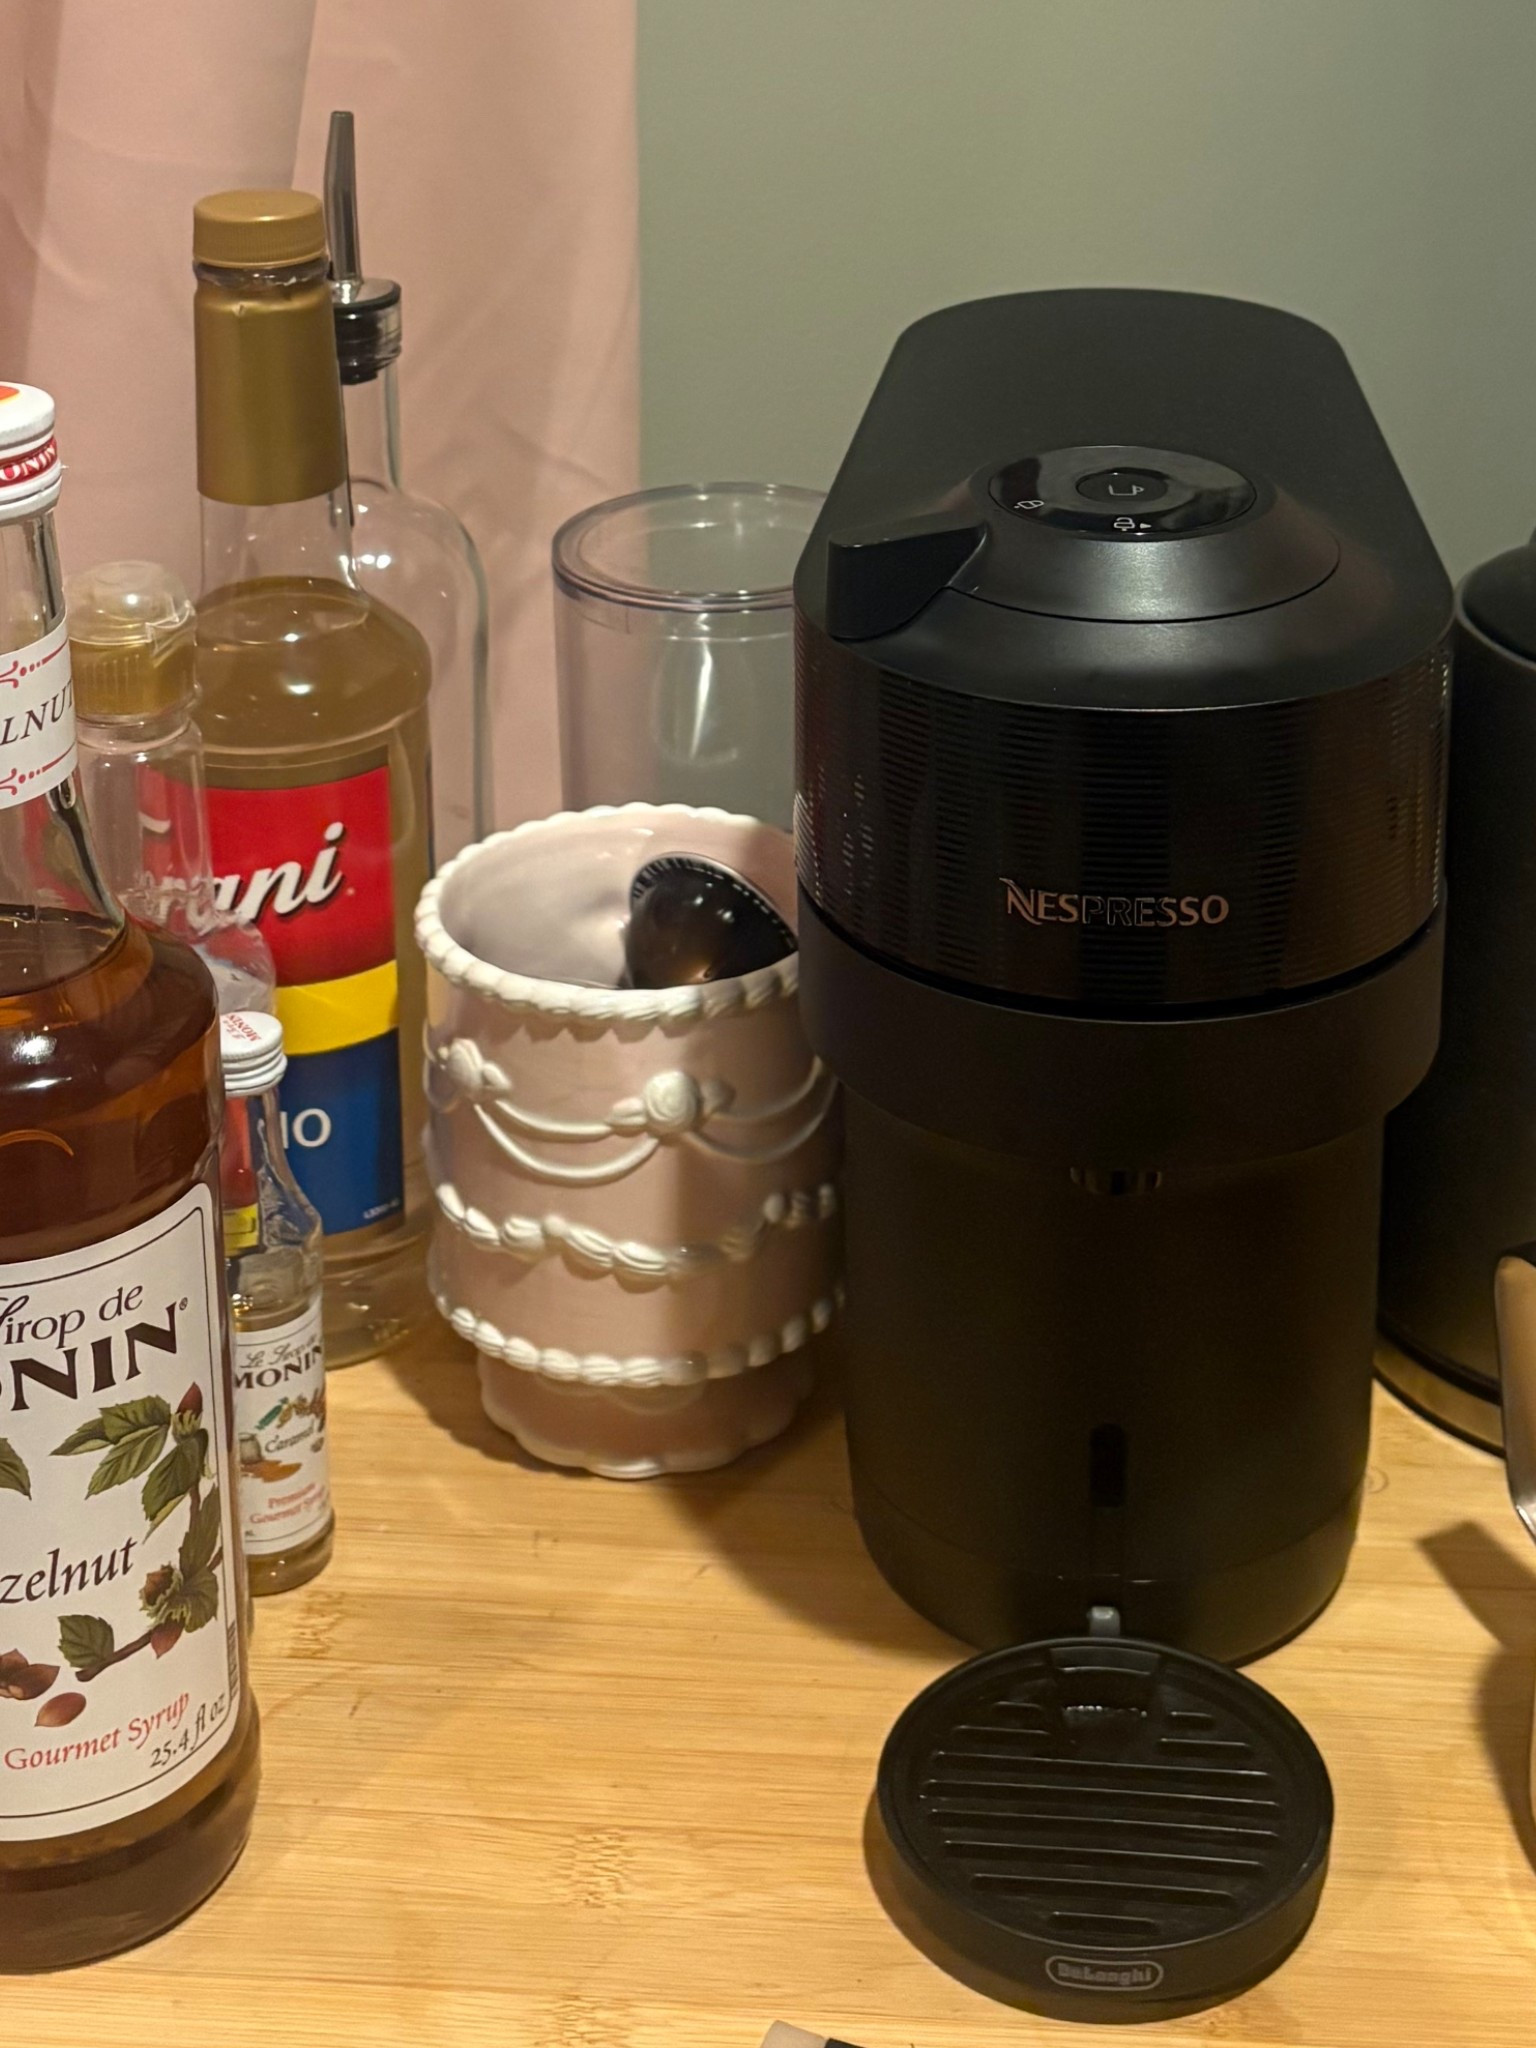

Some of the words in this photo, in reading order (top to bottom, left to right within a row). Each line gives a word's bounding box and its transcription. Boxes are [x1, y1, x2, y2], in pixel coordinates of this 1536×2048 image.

[999, 877, 1230, 927] NESPRESSO
[99, 1285, 144, 1322] de
[0, 1301, 178, 1411] NIN
[0, 1537, 138, 1605] zelnut
[4, 1727, 122, 1770] Gourmet
[128, 1692, 190, 1750] Syrup
[150, 1728, 189, 1768] 25.4
[189, 1703, 206, 1751] fl
